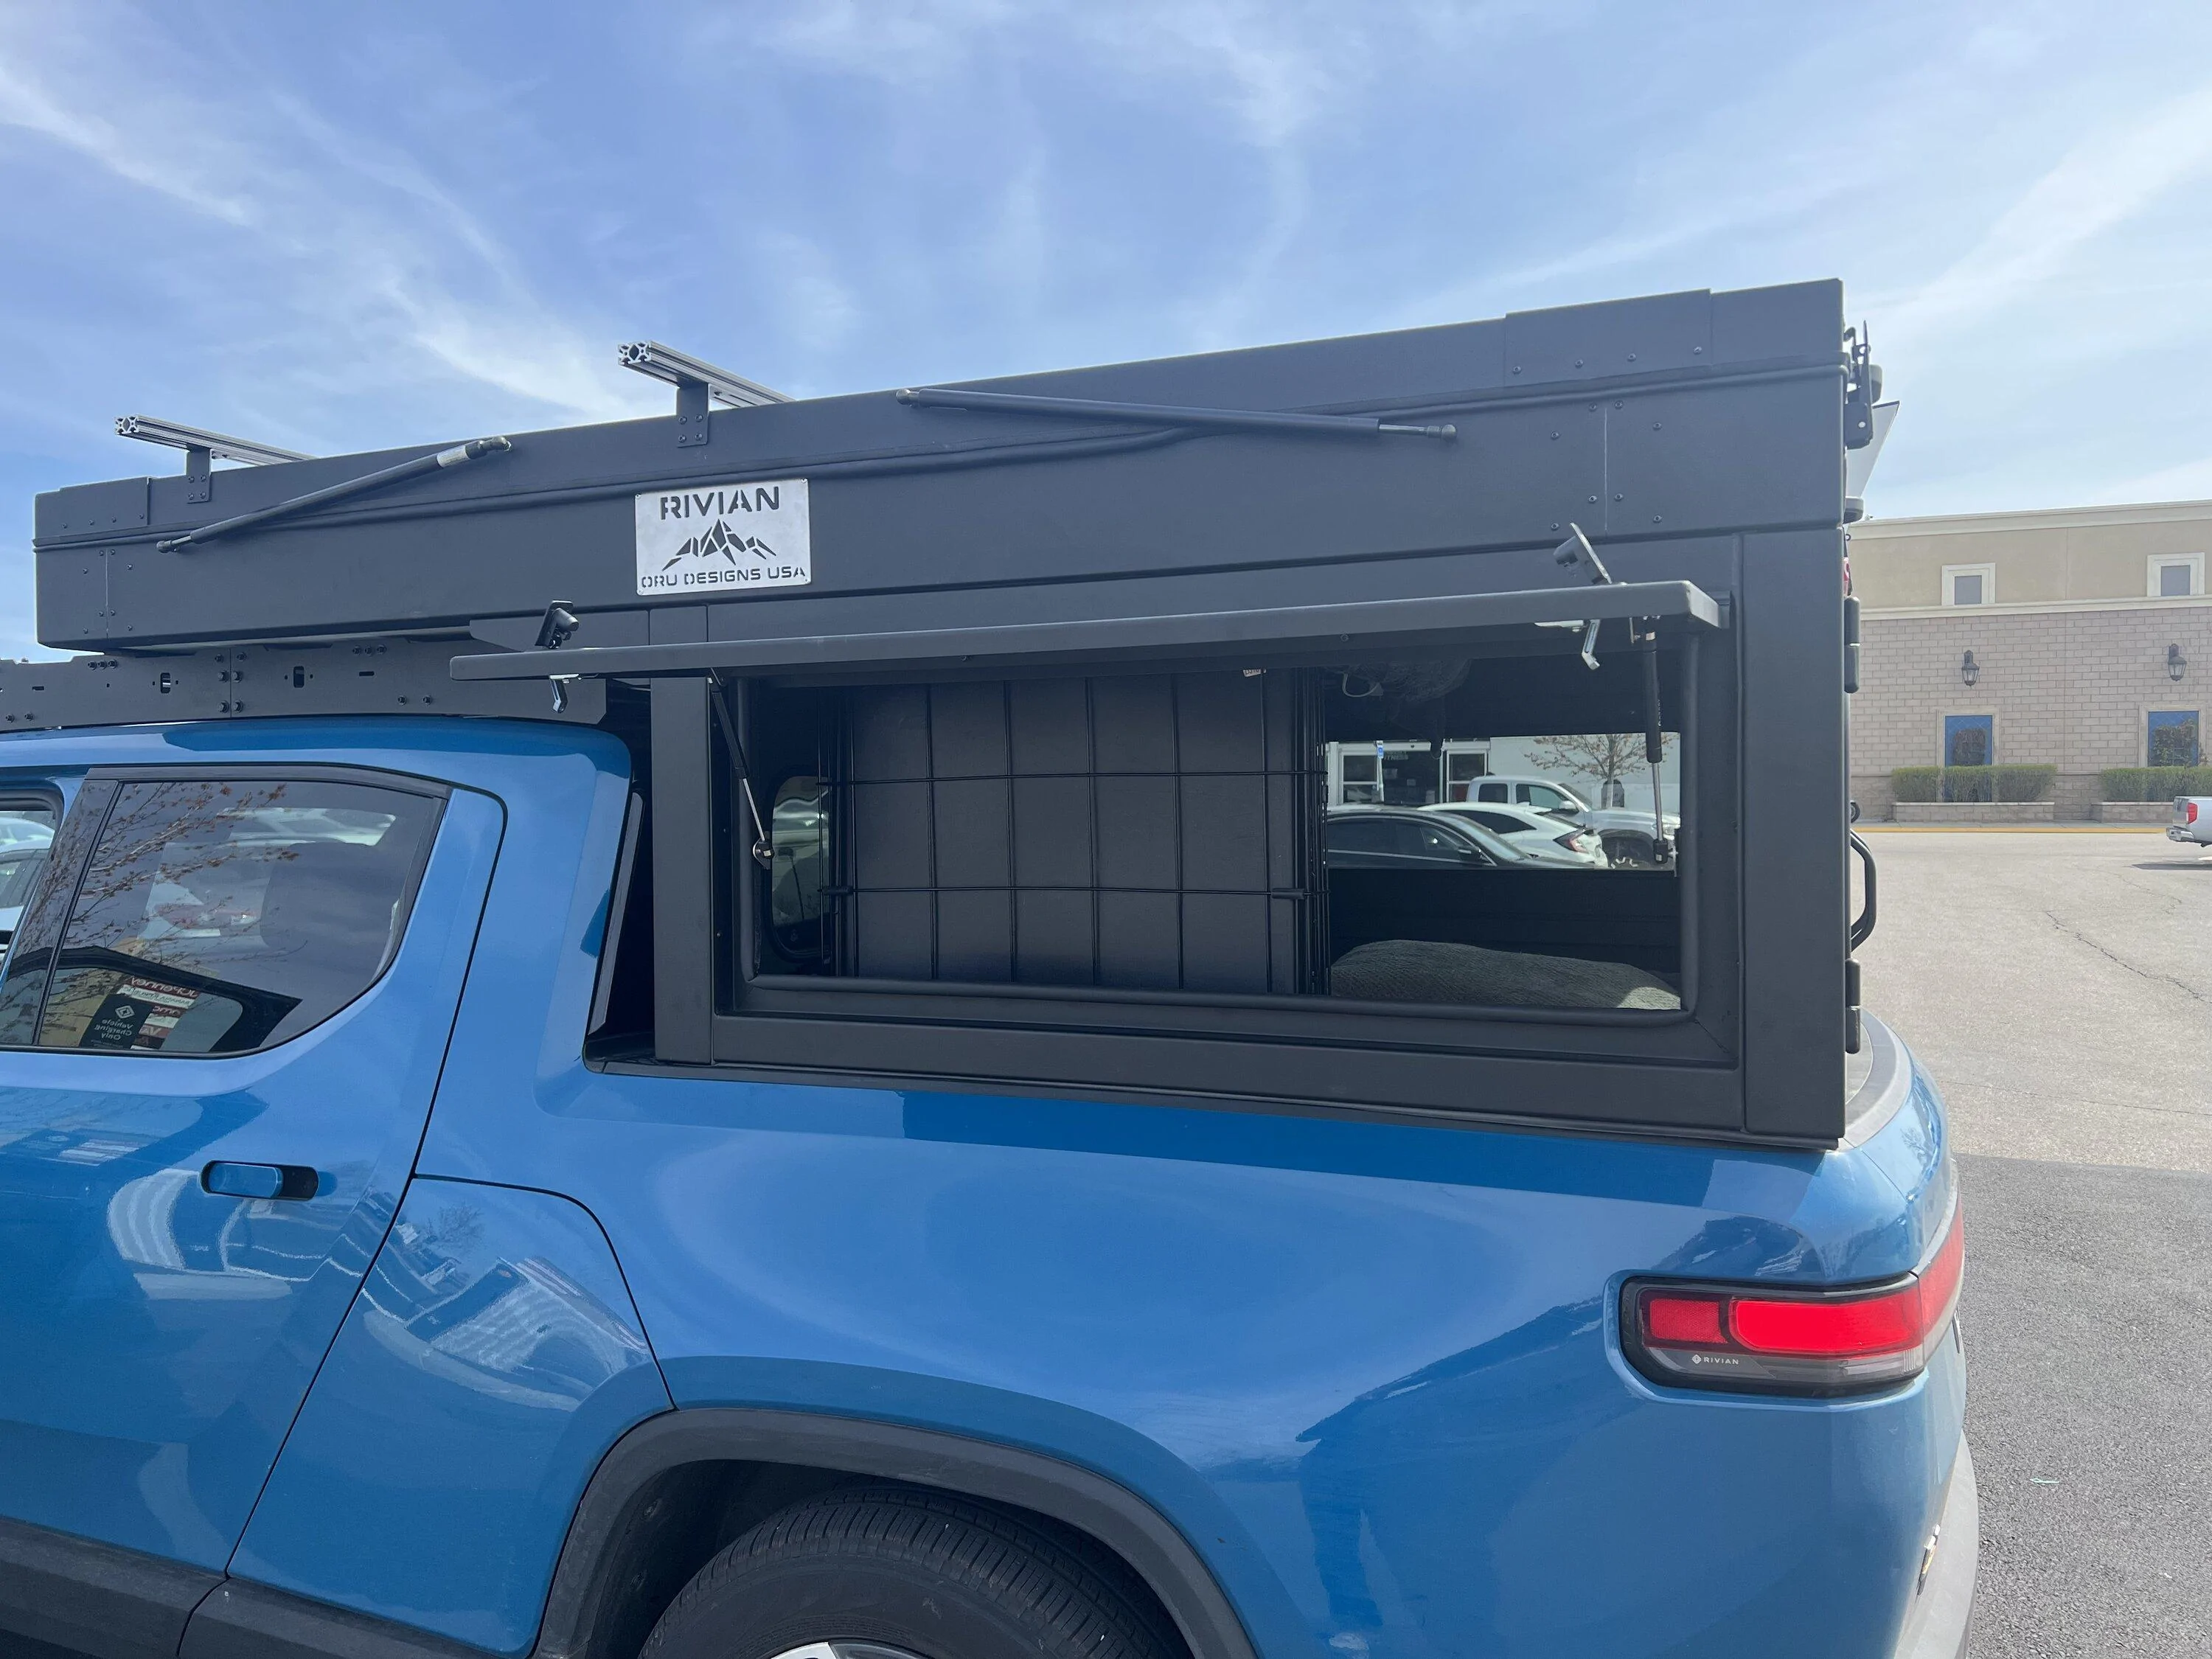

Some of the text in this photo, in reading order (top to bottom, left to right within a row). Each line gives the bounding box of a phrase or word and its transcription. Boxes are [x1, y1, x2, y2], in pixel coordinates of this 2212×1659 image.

[661, 487, 779, 520] RIVIAN
[641, 566, 805, 588] ORU DESIGNS USA
[1703, 1357, 1739, 1365] RIVIAN
